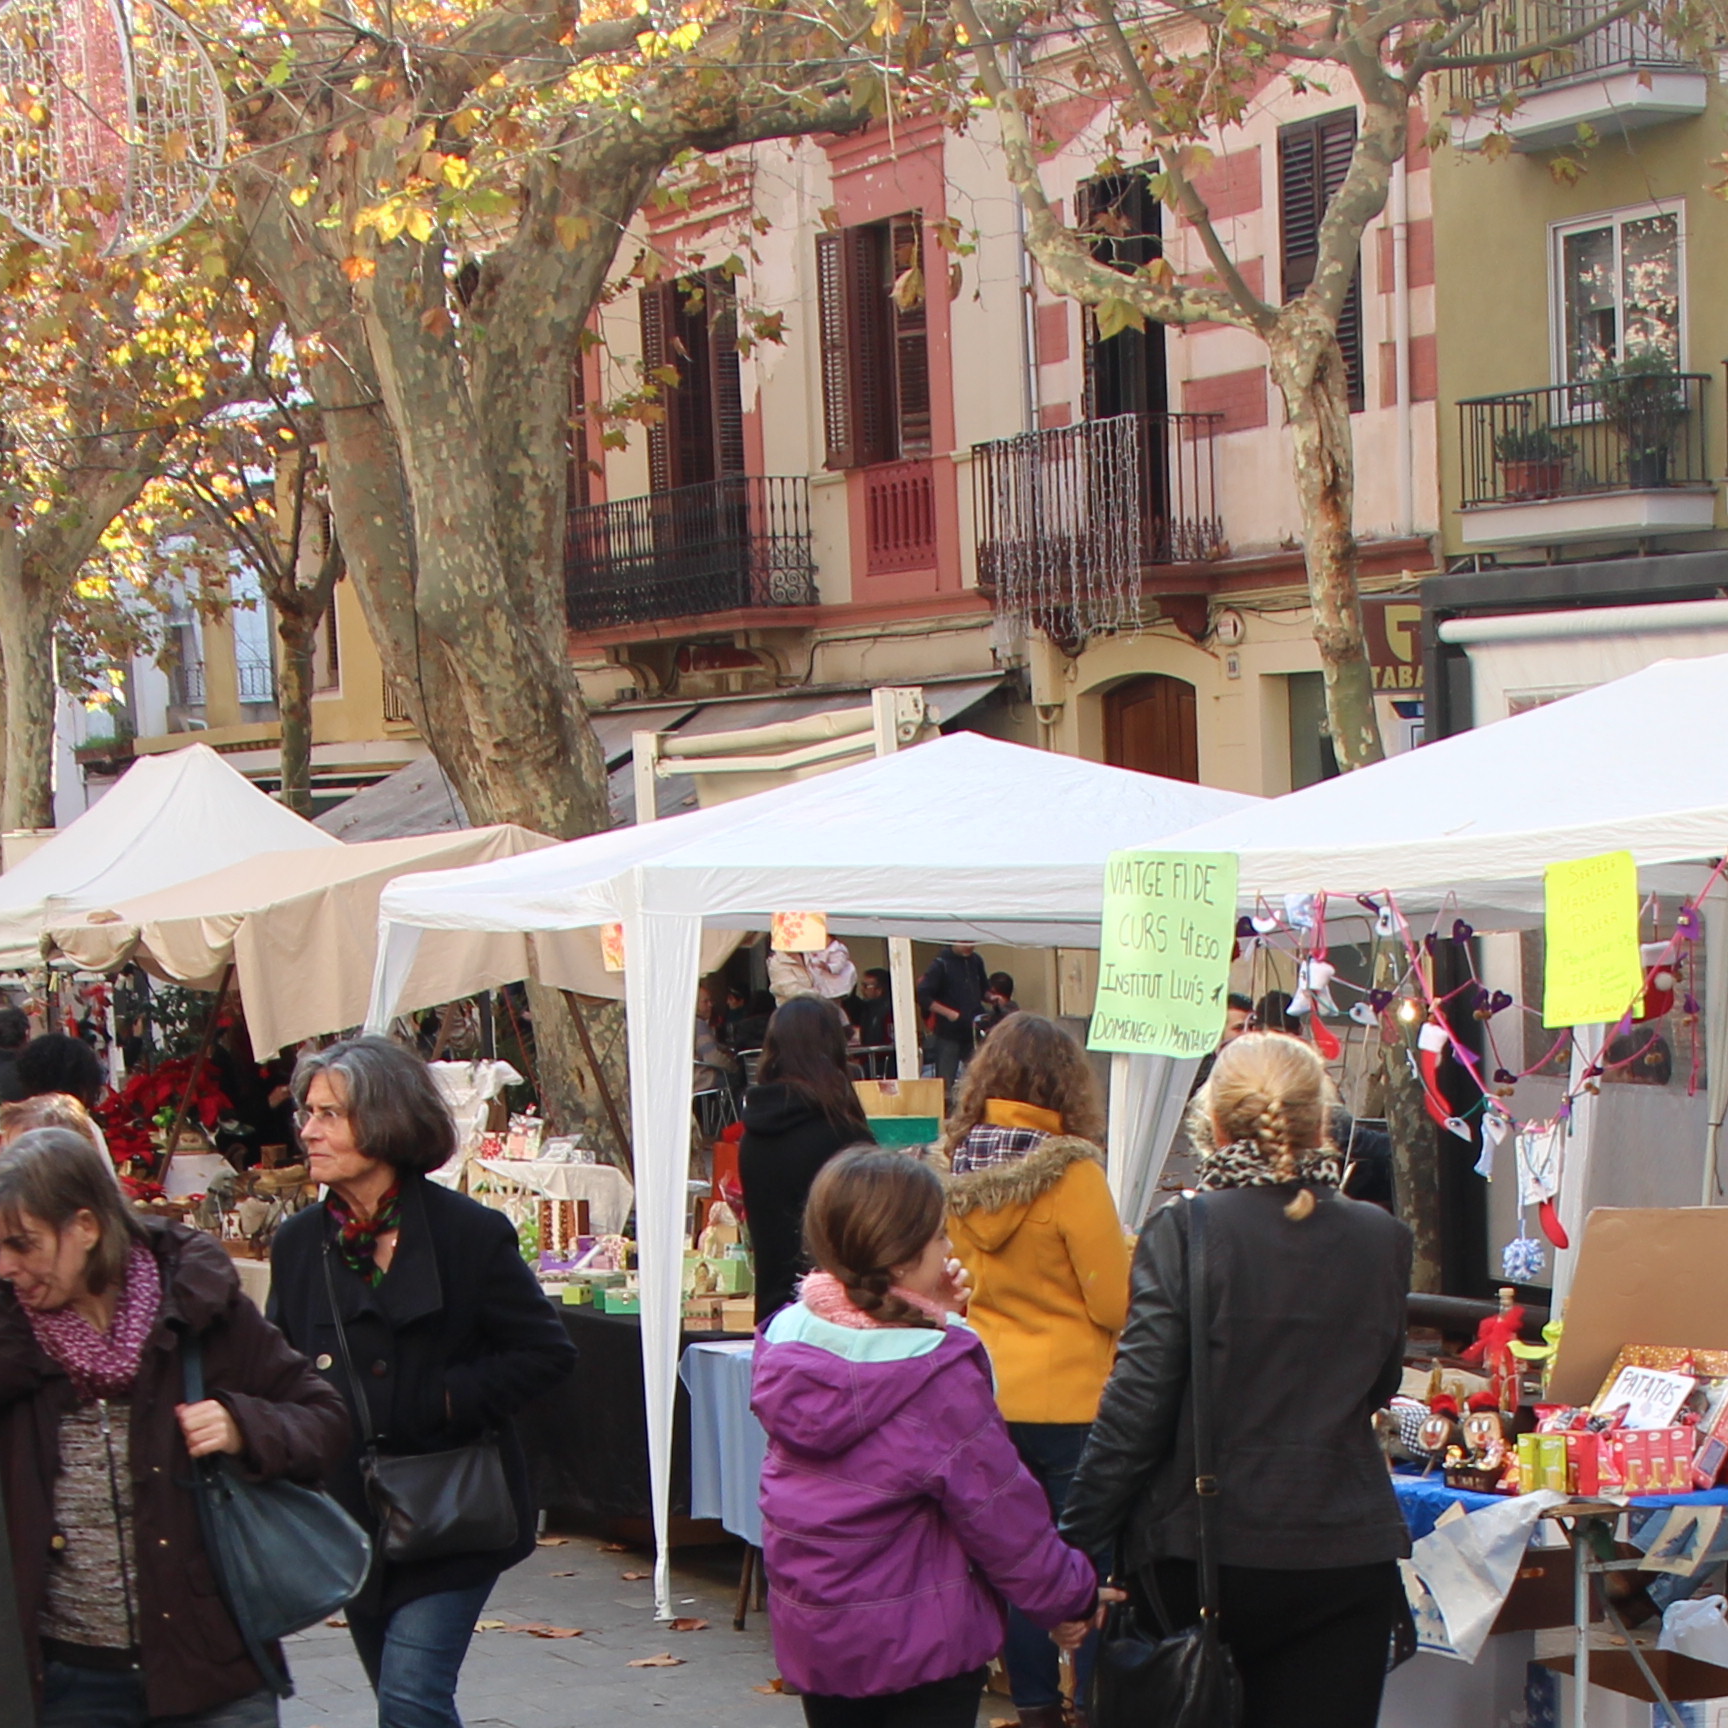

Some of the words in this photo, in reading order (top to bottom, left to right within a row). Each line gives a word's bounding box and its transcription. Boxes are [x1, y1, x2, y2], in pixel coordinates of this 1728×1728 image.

[1110, 860, 1166, 898] VIATGE
[1173, 860, 1188, 900] FI
[1193, 863, 1217, 906] DE
[1118, 911, 1169, 953] CURS
[1616, 1370, 1683, 1407] PATATAS
